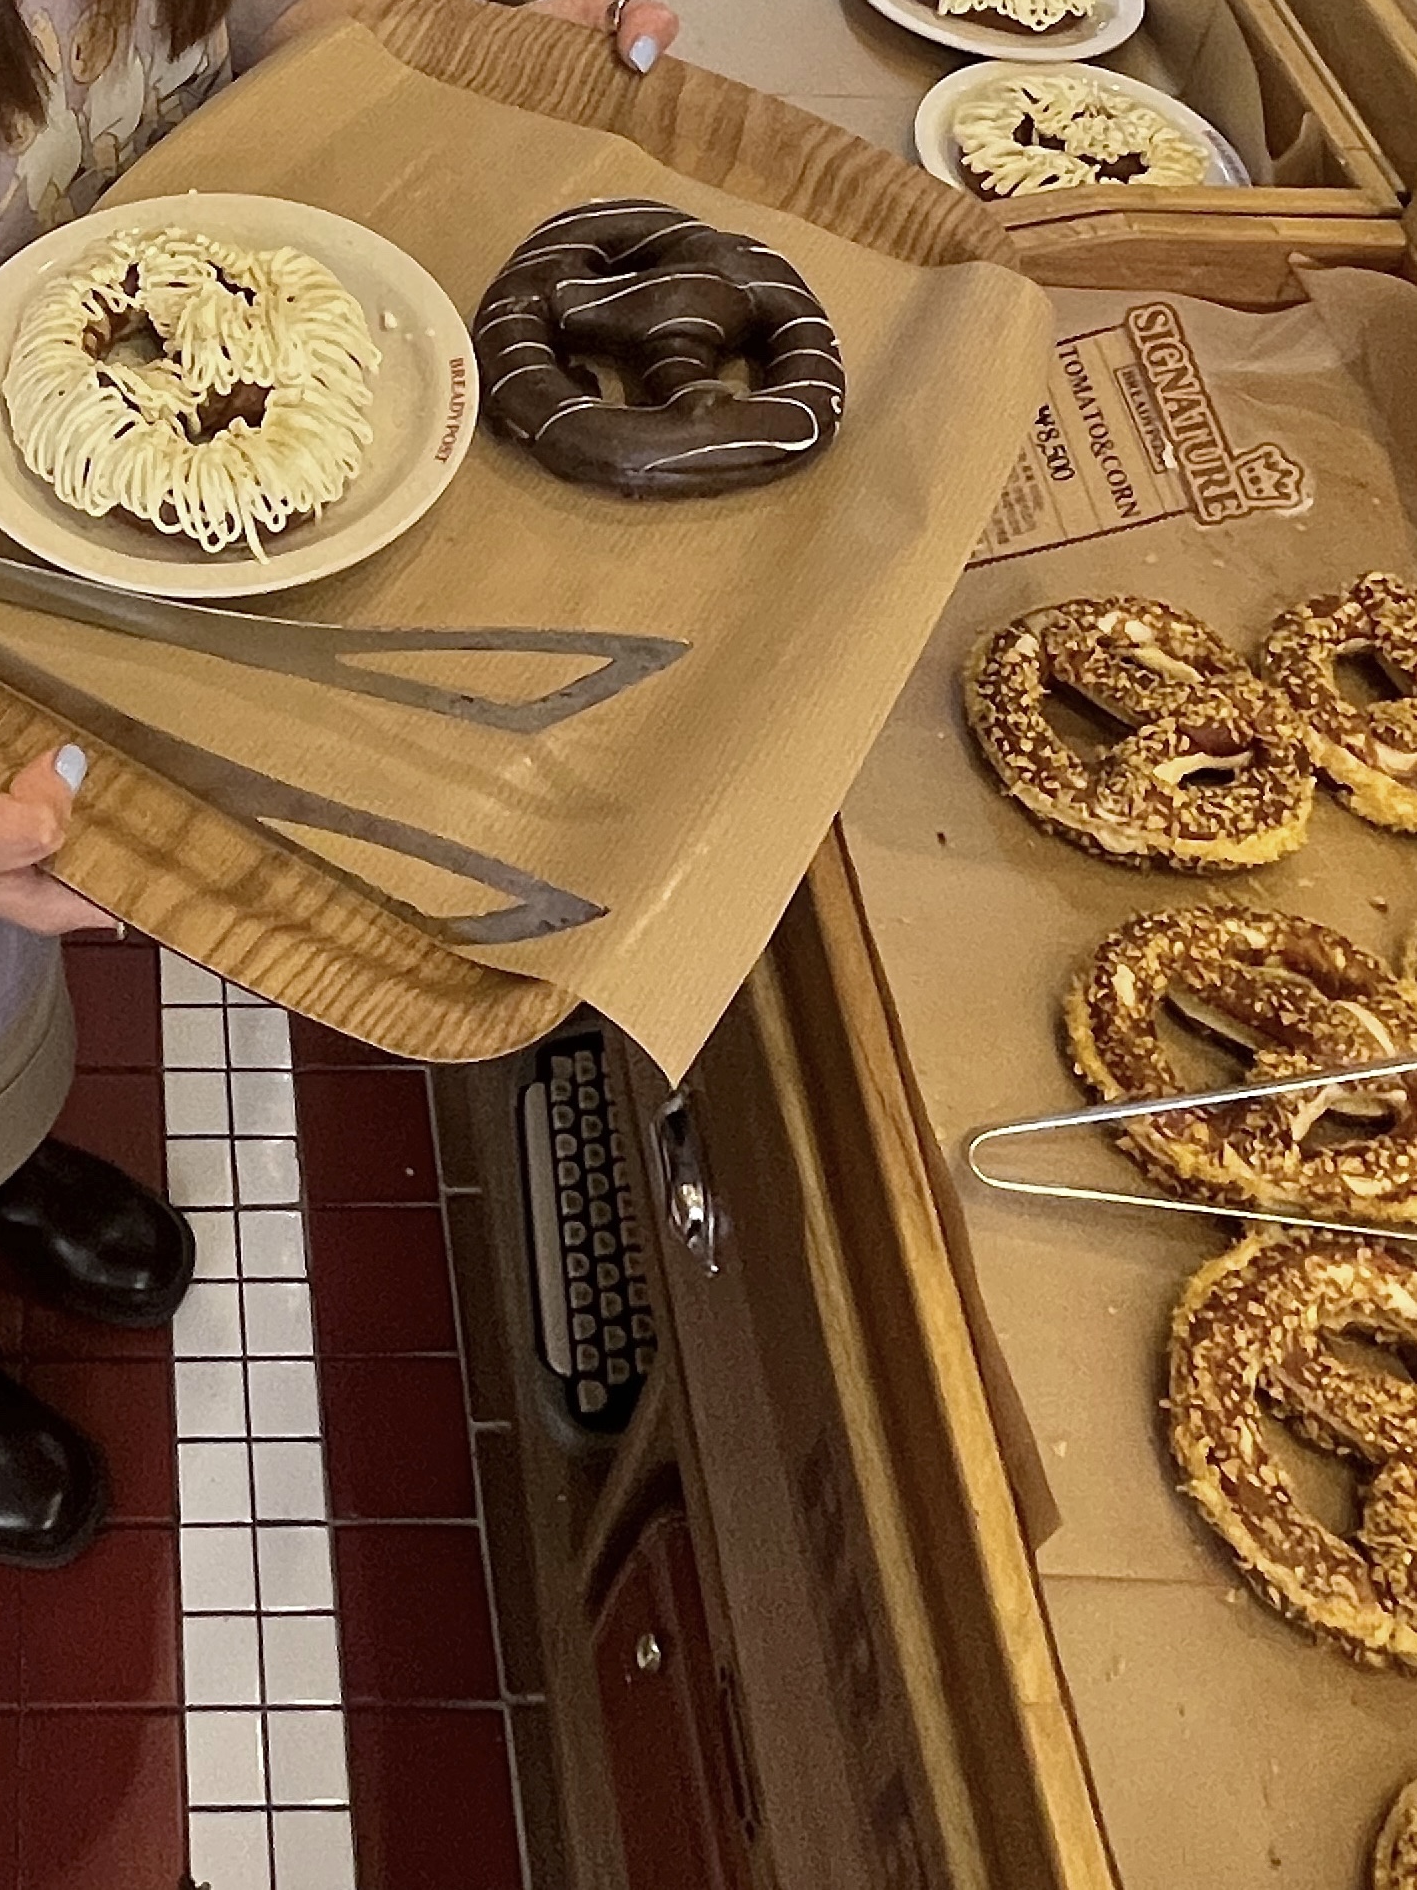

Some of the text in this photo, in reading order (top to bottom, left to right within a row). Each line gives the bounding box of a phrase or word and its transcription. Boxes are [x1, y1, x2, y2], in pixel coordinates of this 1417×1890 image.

[433, 356, 466, 463] BREADYPOST
[1034, 404, 1076, 482] ₩8,500
[1058, 343, 1141, 519] TOMATO&CORN
[1133, 305, 1244, 520] SIGNATURE
